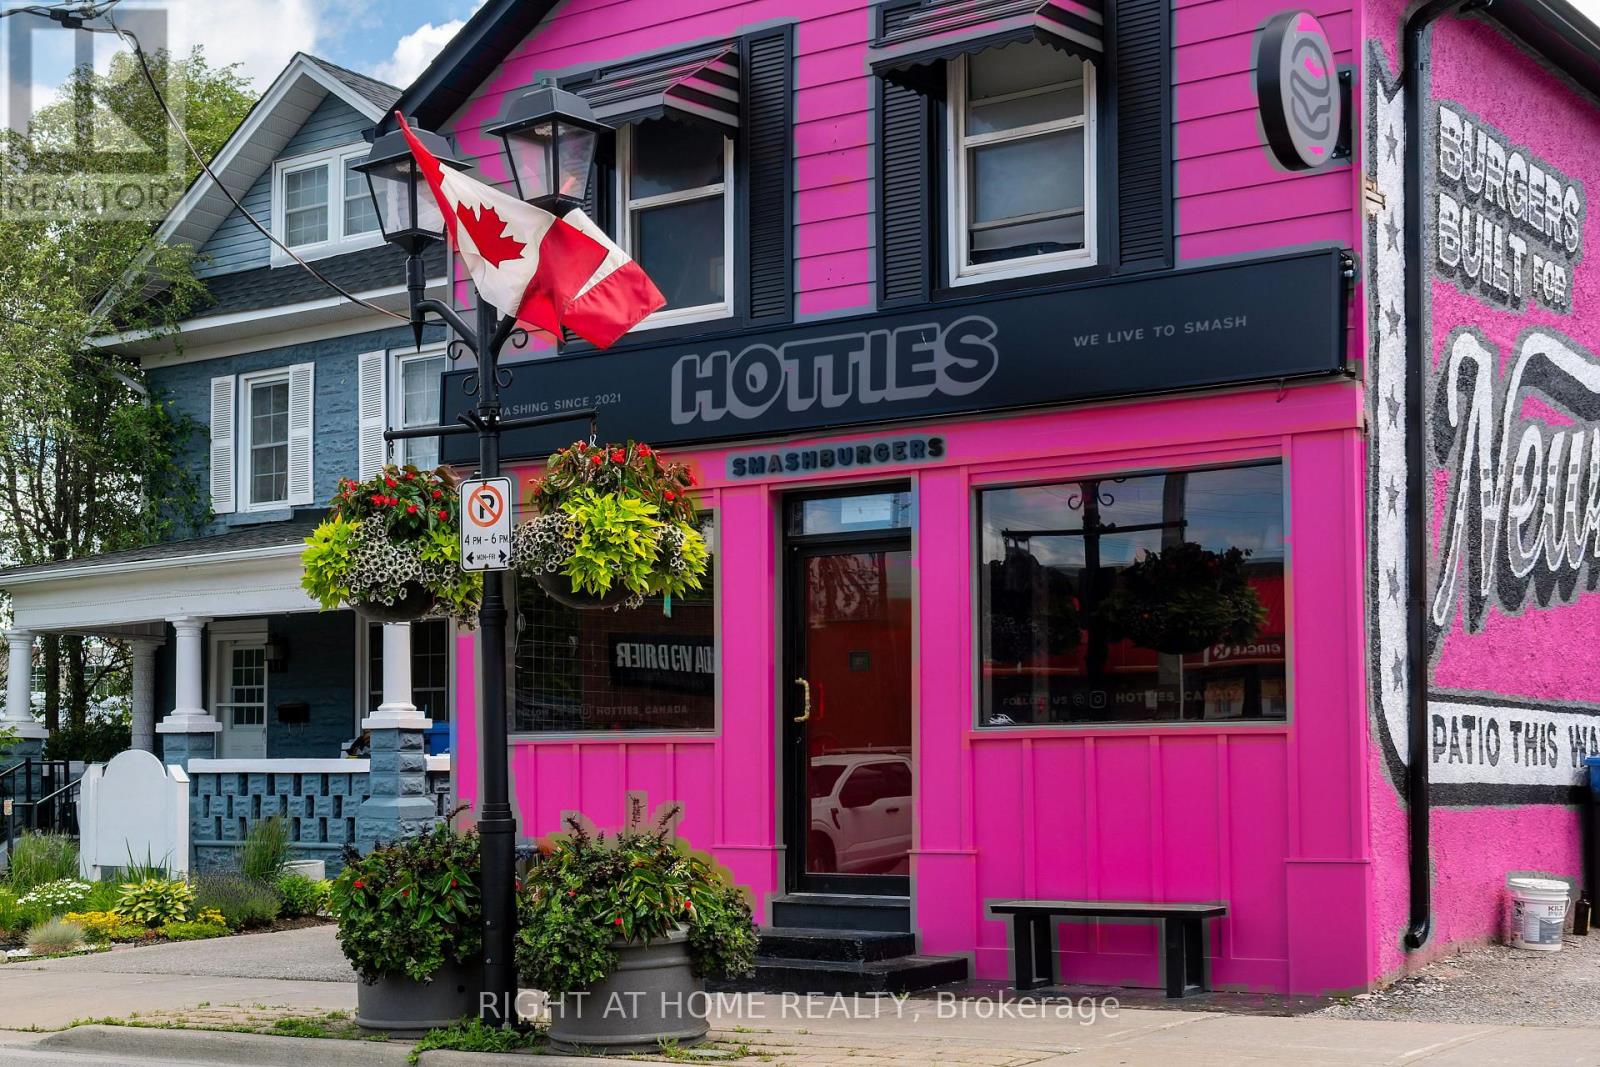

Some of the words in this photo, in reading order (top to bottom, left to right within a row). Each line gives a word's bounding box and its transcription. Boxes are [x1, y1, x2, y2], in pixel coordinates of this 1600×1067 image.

[1438, 105, 1581, 255] BURGERS
[1438, 192, 1527, 298] BUILT
[1532, 254, 1567, 306] FOR
[1073, 334, 1100, 347] WE
[1107, 328, 1145, 343] LIVE
[1153, 325, 1176, 337] TO
[1184, 315, 1247, 334] SMASH
[671, 315, 999, 425] HOTTIES
[554, 396, 590, 410] SINCE
[594, 392, 622, 405] 2021
[731, 437, 945, 477] SMASHBURGERS
[464, 534, 470, 546] 4
[473, 536, 482, 545] PM
[491, 533, 497, 545] 6
[1432, 714, 1501, 767] PATIO
[1509, 720, 1558, 768] THIS
[1569, 724, 1600, 768] WA
